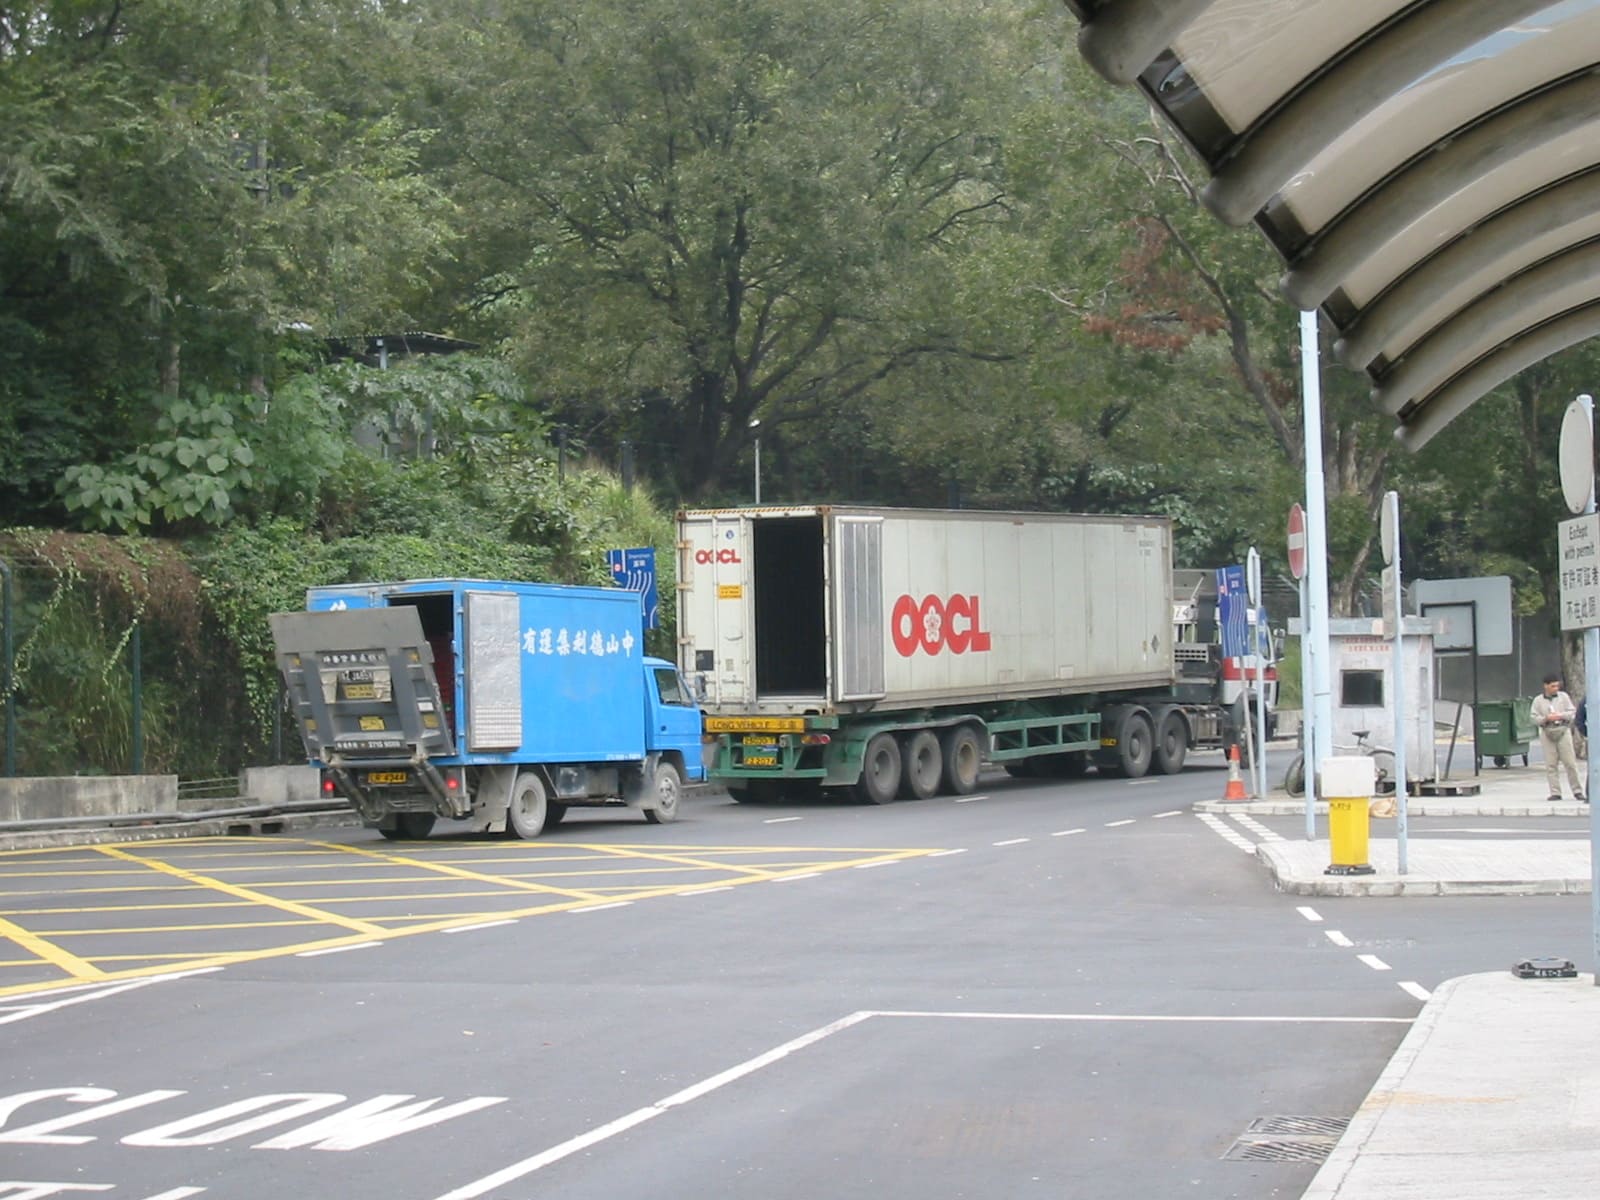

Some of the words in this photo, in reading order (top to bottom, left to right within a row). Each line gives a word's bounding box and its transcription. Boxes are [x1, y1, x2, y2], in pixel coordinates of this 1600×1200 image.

[695, 549, 741, 565] OOCL
[1576, 541, 1595, 559] permit
[892, 593, 991, 657] OOCL
